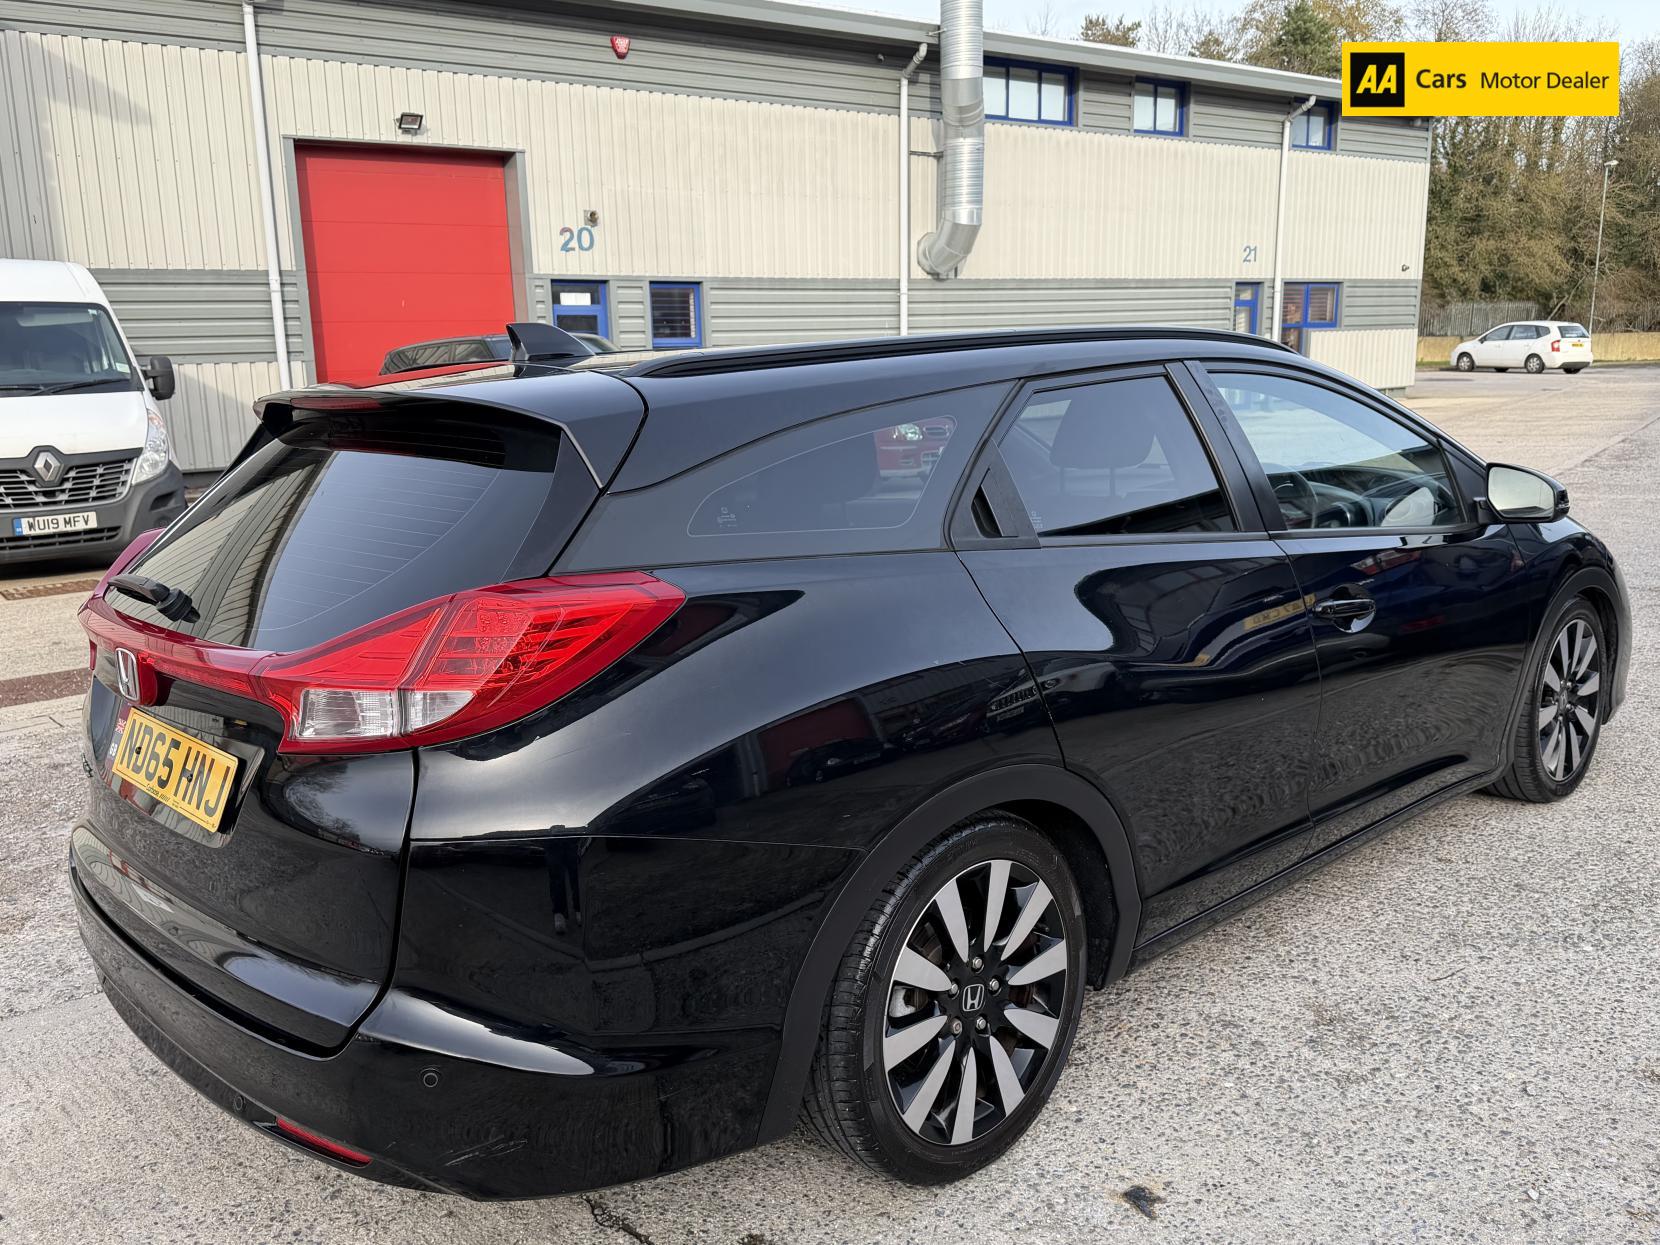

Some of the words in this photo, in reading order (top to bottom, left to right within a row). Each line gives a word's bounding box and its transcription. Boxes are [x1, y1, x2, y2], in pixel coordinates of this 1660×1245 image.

[559, 226, 594, 252] 20
[1242, 245, 1257, 263] 21
[27, 517, 60, 532] WU19
[63, 514, 90, 528] MFV
[119, 718, 182, 790] ND65
[173, 746, 231, 818] HNJ
